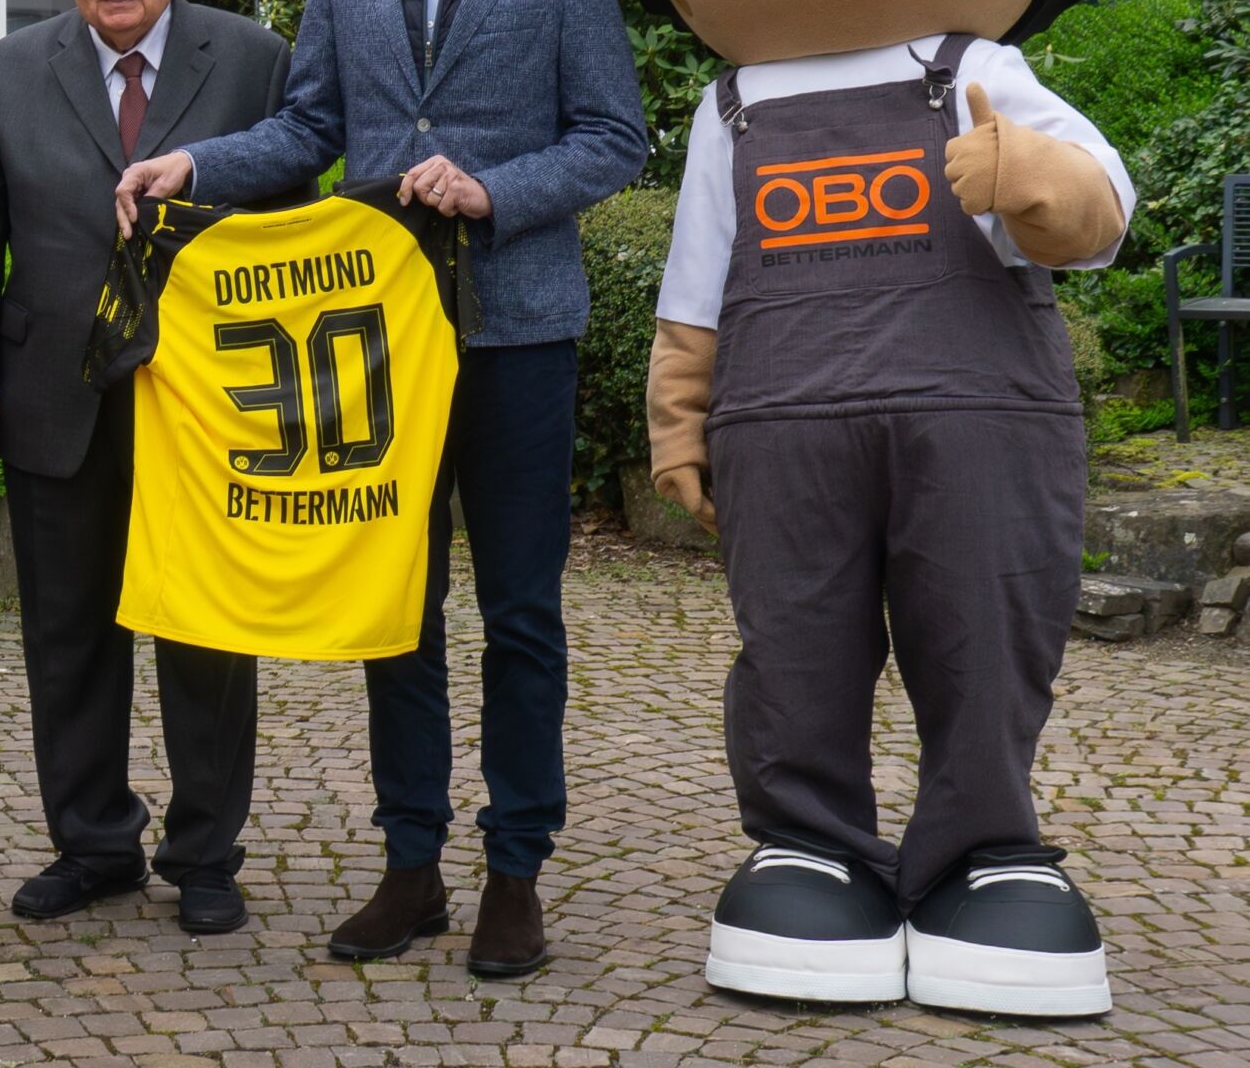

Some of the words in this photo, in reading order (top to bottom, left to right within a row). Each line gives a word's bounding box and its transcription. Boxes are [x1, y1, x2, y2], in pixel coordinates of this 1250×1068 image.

[755, 165, 931, 232] OBO
[213, 248, 376, 307] DORTMUND
[761, 239, 933, 268] BETTERMANN
[213, 302, 395, 477] 30
[226, 479, 400, 525] BETTERMANN
